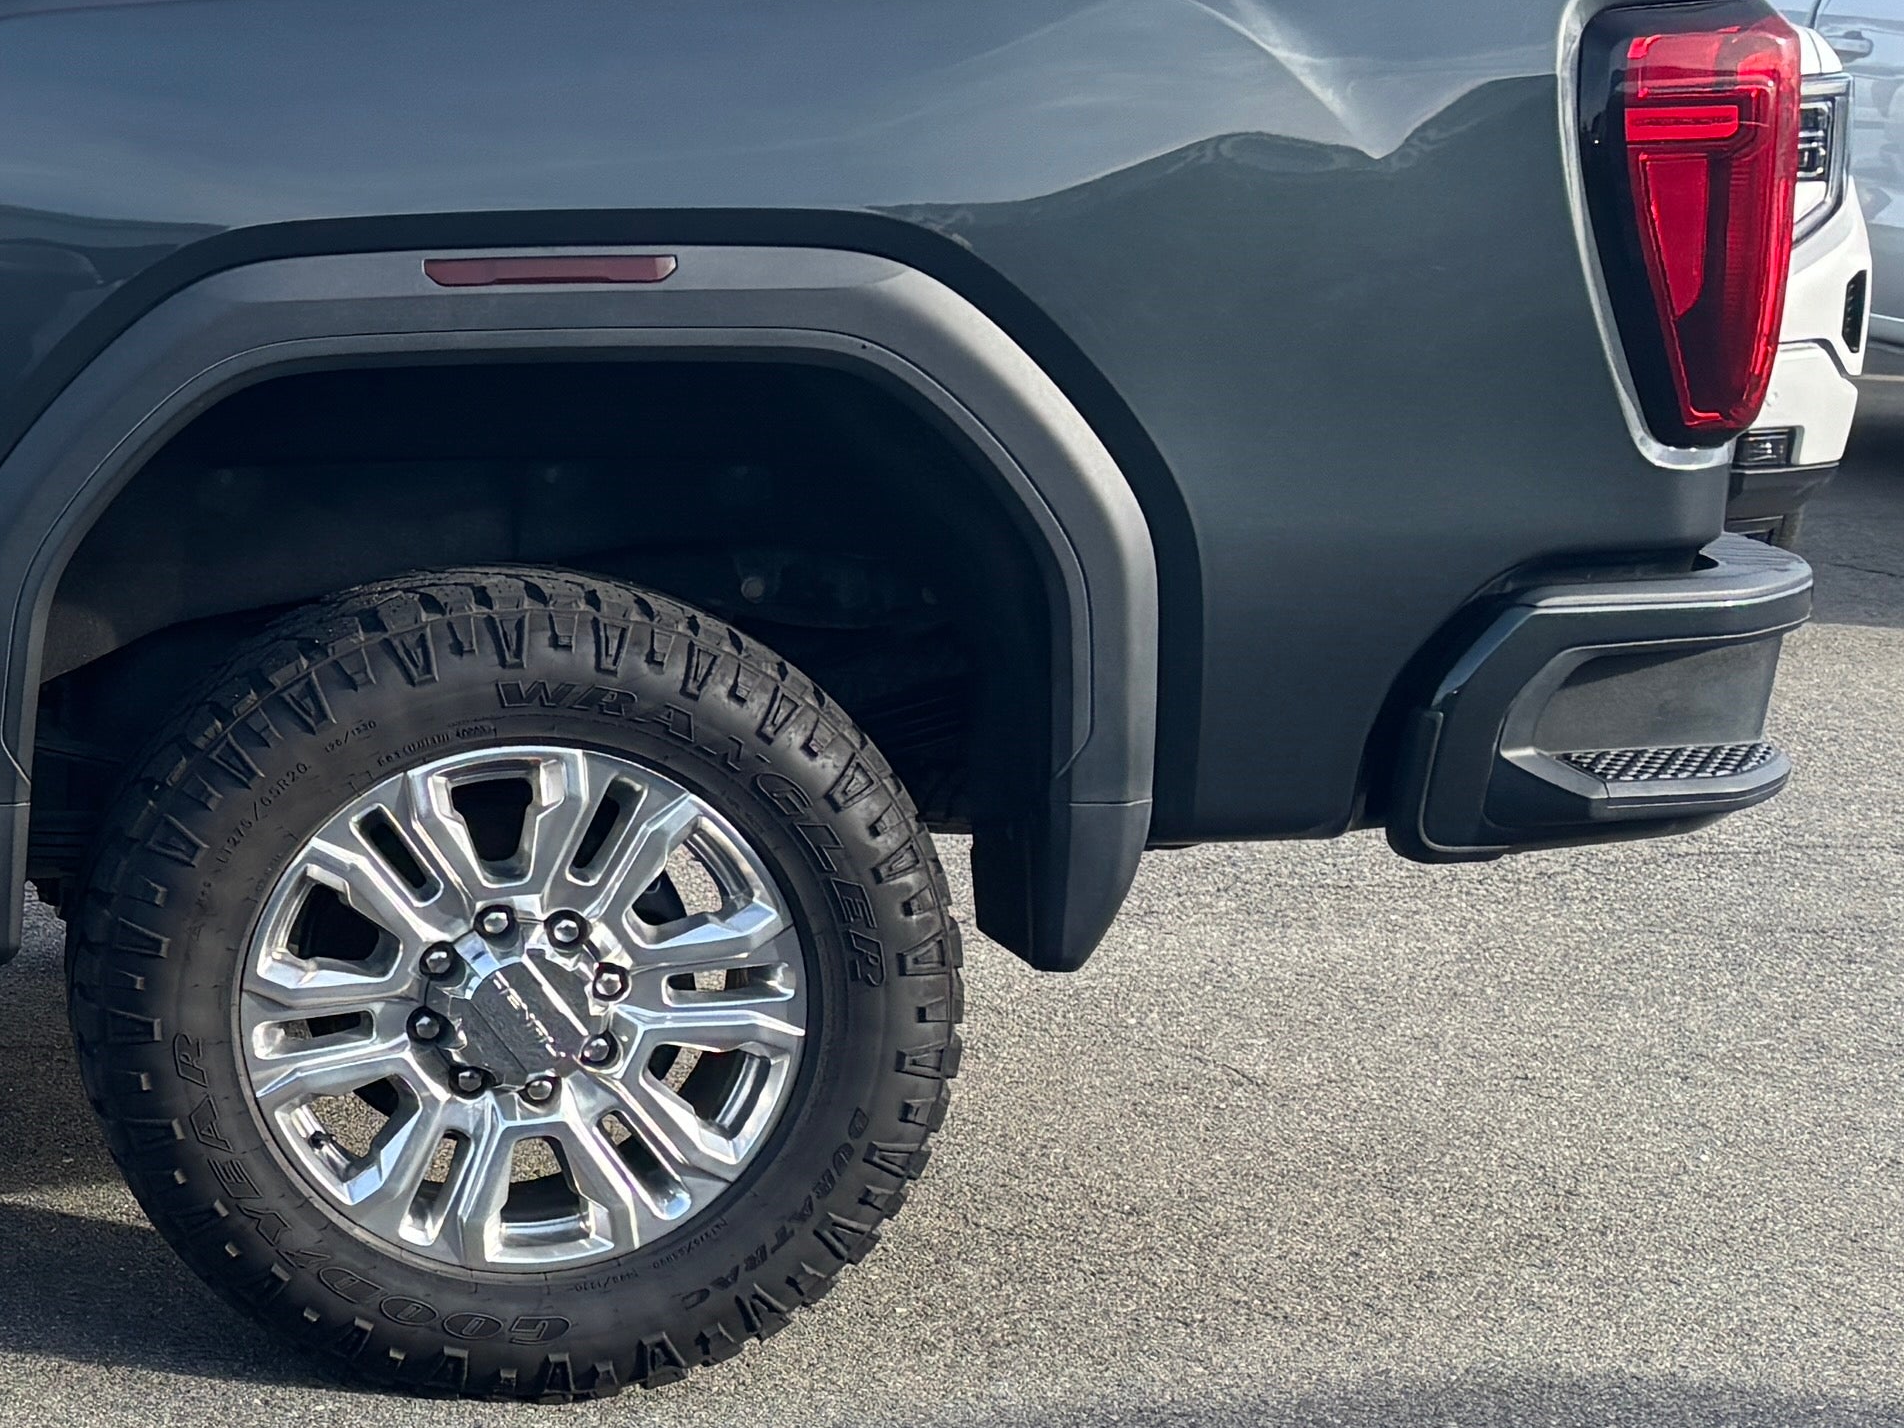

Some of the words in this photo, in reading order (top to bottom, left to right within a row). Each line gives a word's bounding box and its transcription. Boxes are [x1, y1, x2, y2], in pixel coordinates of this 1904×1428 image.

[496, 680, 885, 988] WRANGLER
[172, 1032, 572, 1345] GOODYEAR
[680, 1107, 869, 1309] DURATRAC
